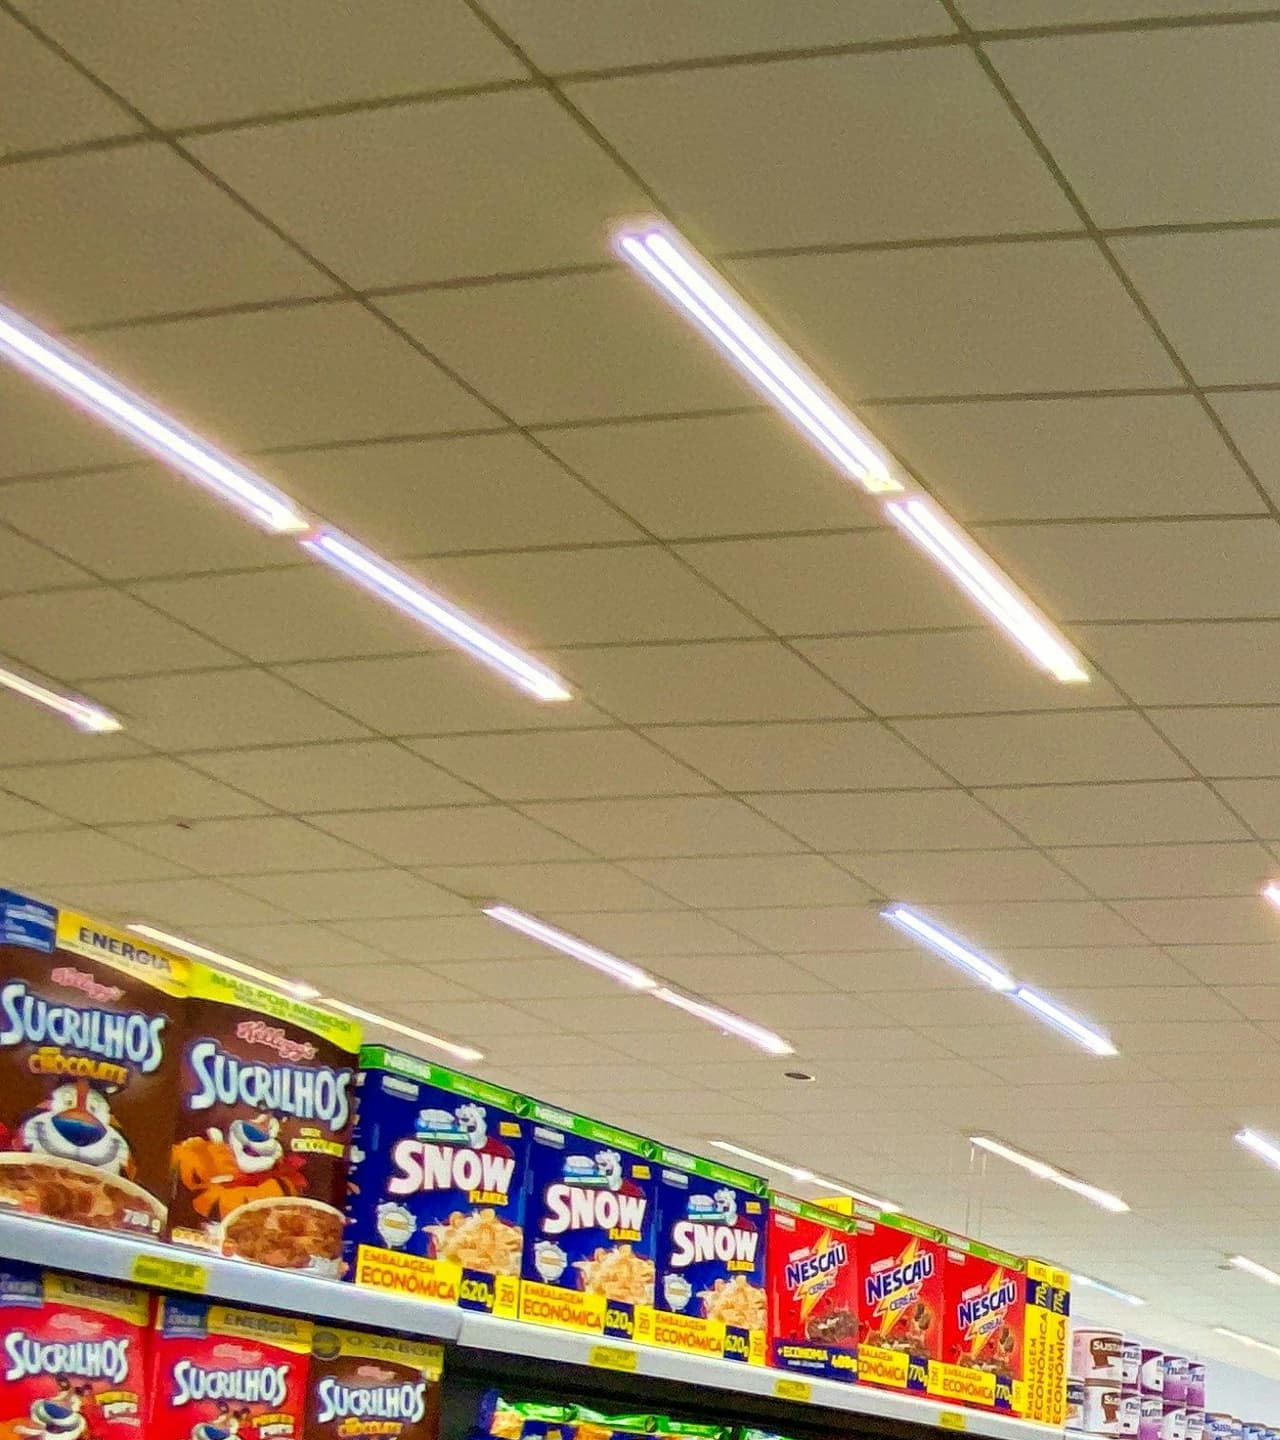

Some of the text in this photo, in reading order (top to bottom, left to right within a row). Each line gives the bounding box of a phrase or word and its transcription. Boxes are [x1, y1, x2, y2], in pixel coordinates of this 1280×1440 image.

[79, 927, 172, 971] ENERGIA
[0, 982, 165, 1073] SUCRILHOS
[189, 1041, 351, 1131] SUCRILHOS
[388, 1139, 515, 1194] SNOW
[542, 1184, 647, 1234] SNOW
[363, 1250, 434, 1275] EMBALAGEM
[671, 1221, 759, 1267] SNOW
[786, 1244, 846, 1288] NESCAU
[361, 1265, 456, 1303] ECONÔMICA
[525, 1285, 584, 1304] EMBALAGEM
[867, 1253, 934, 1304] NESCAU
[524, 1299, 600, 1329] ECONÔMICA
[958, 1281, 1017, 1328] NESCAU
[4, 1330, 130, 1383] SUCRILHOS
[654, 1325, 723, 1349] ECONÔMICA
[858, 1348, 893, 1362] BALAGEM
[172, 1360, 289, 1407] SUCRILHOS
[317, 1379, 426, 1423] SUCRILHOS
[942, 1378, 993, 1402] ECONÔMICA
